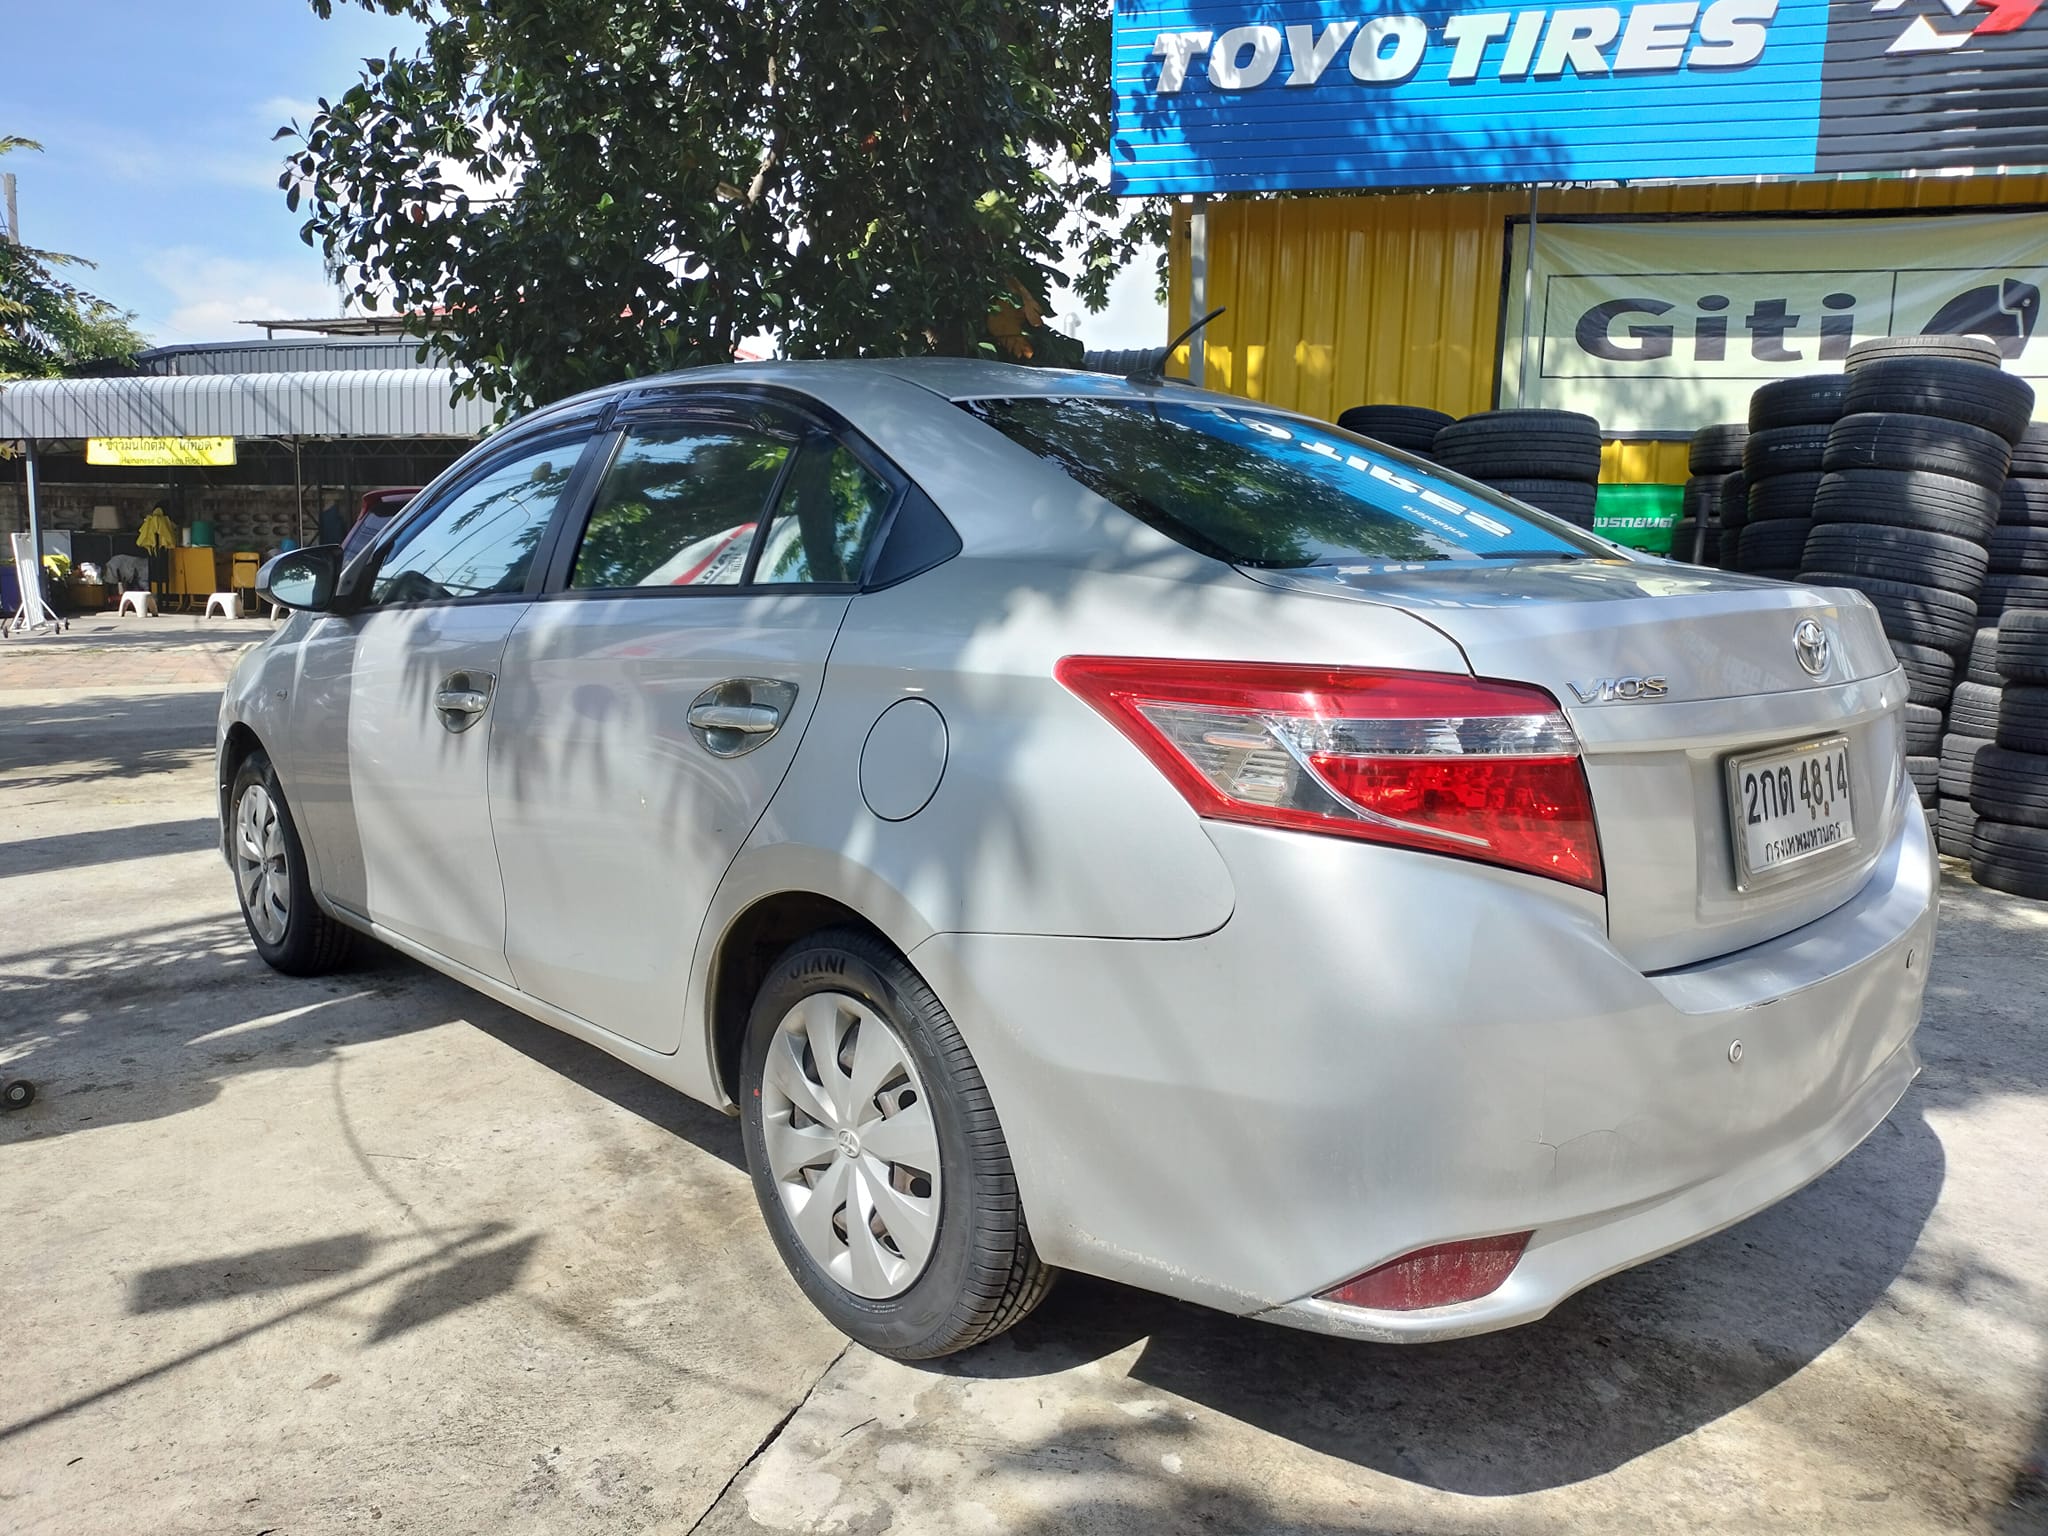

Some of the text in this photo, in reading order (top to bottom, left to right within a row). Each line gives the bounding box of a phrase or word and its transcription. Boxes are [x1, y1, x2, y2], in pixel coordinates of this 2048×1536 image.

[1150, 15, 1427, 94] TOYO
[1441, 0, 1780, 83] TIRES
[1574, 292, 1857, 363] Giti
[1566, 675, 1668, 704] VIOS
[1800, 752, 1848, 808] 4814
[1765, 822, 1841, 862] กรงเทพมหานคร
